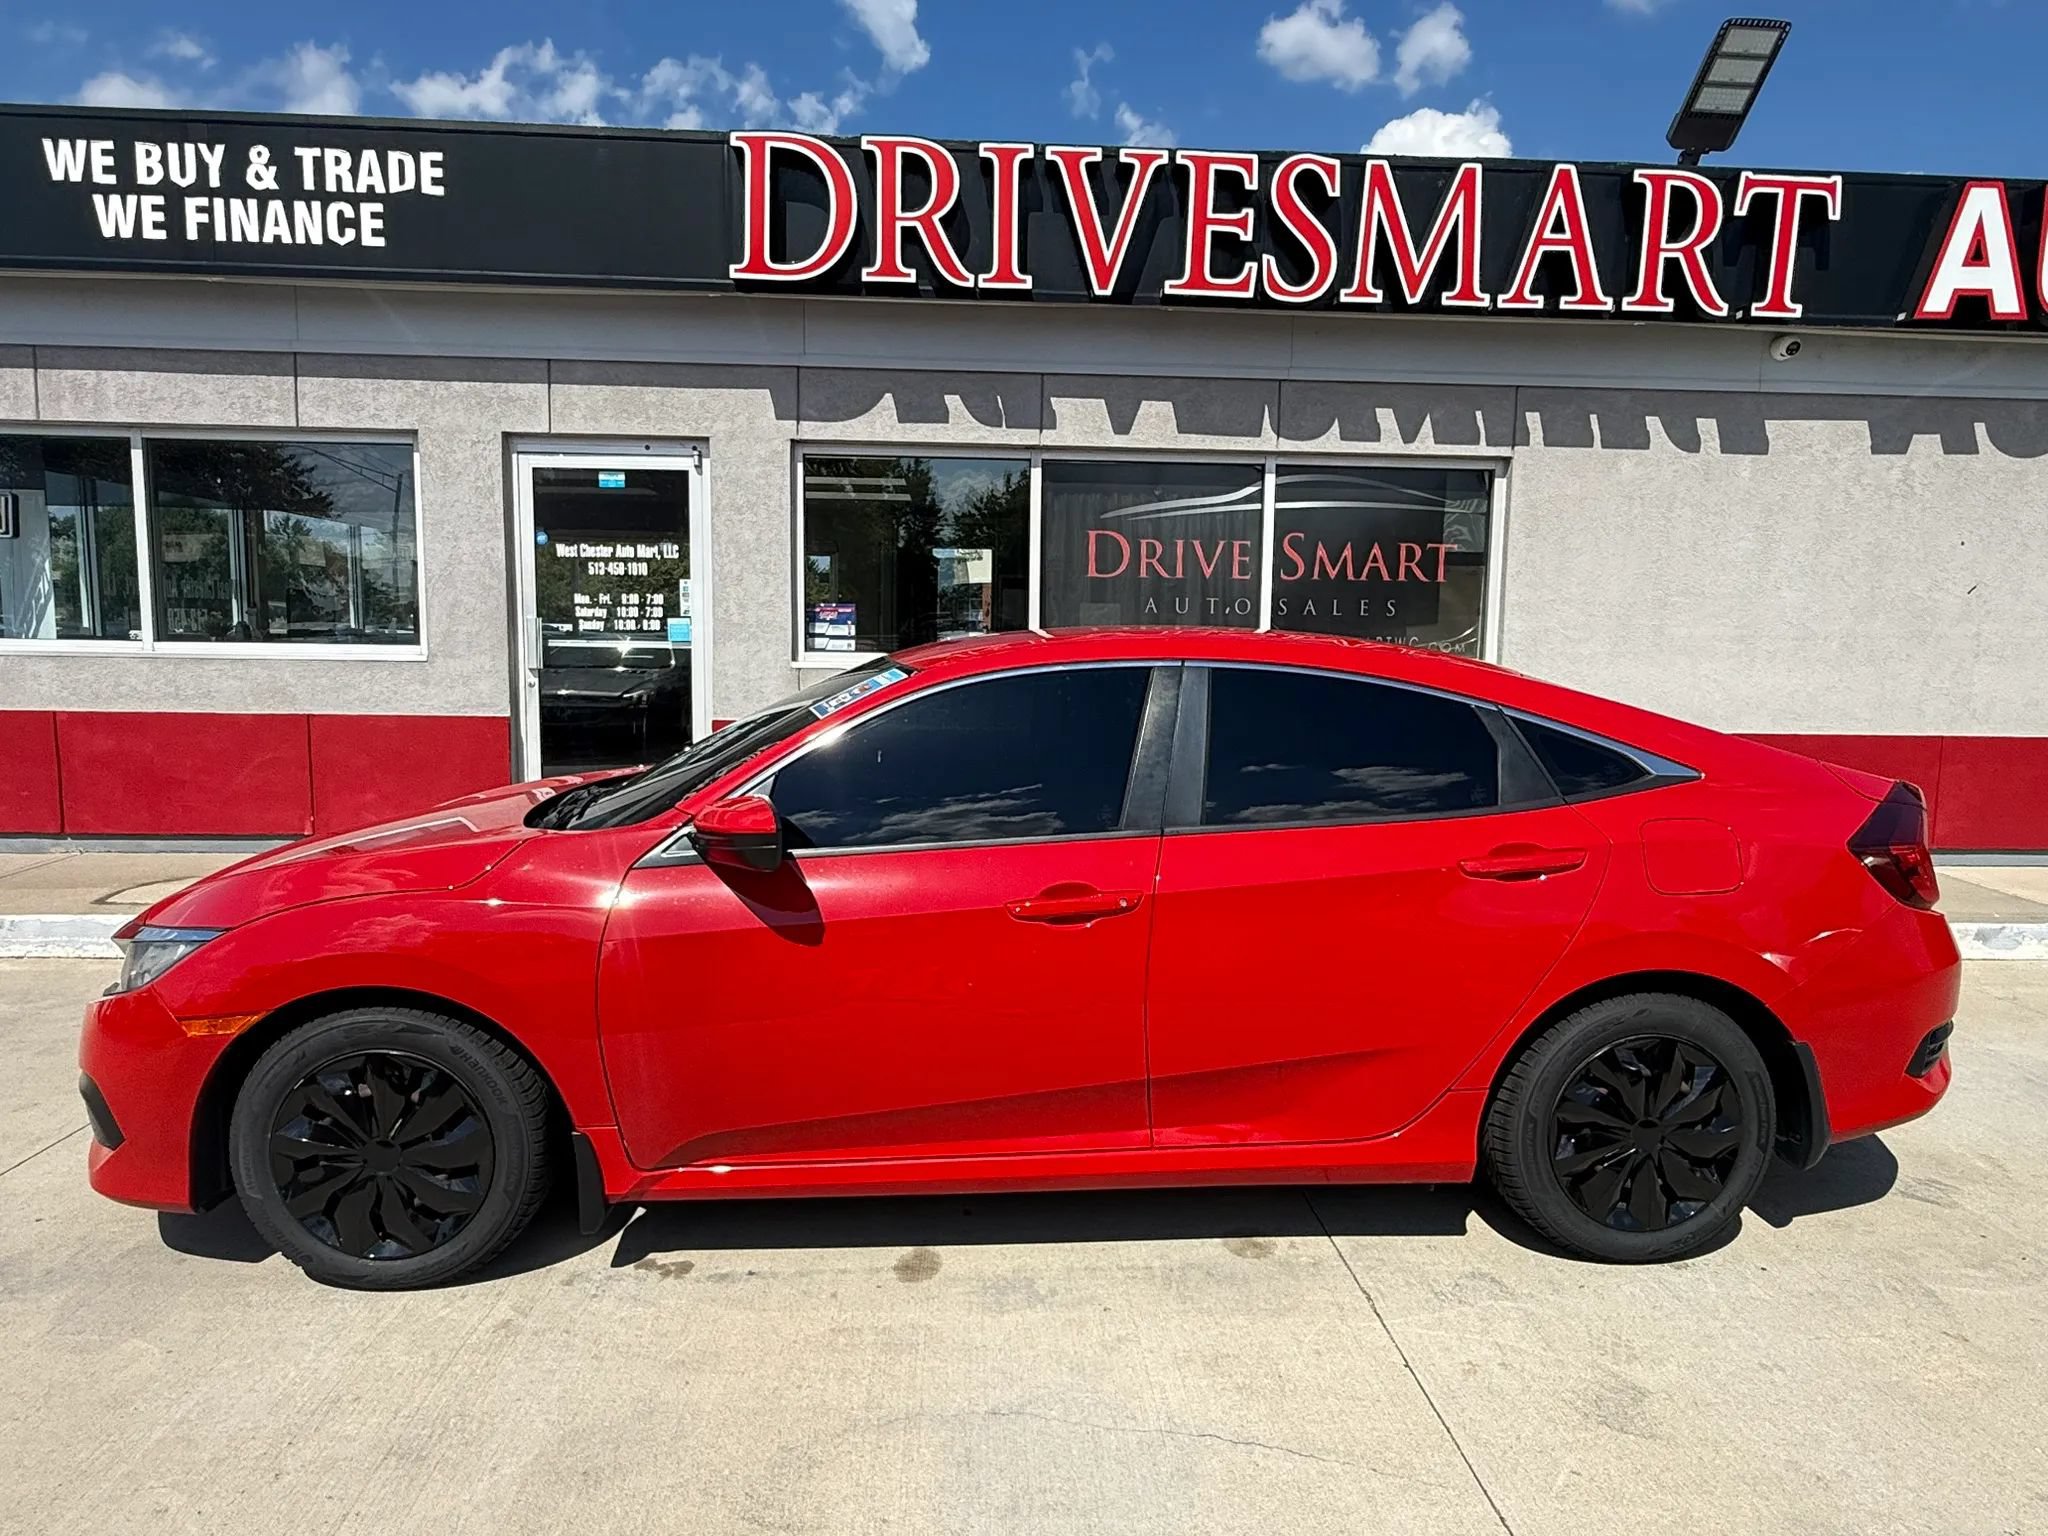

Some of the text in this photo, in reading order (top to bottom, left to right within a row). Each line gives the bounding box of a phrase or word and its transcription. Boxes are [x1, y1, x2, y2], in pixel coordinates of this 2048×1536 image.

[42, 138, 445, 196] WE BUY & TRADE
[92, 193, 386, 247] WE FINANCE
[728, 129, 1843, 319] DRIVESMART
[556, 543, 679, 560] West Chester Auto Mart, LLC
[1087, 529, 1458, 584] DRIVE SMART
[574, 605, 608, 619] Saturday
[1144, 596, 1397, 617] AUTO SALES
[578, 618, 605, 633] Sunday
